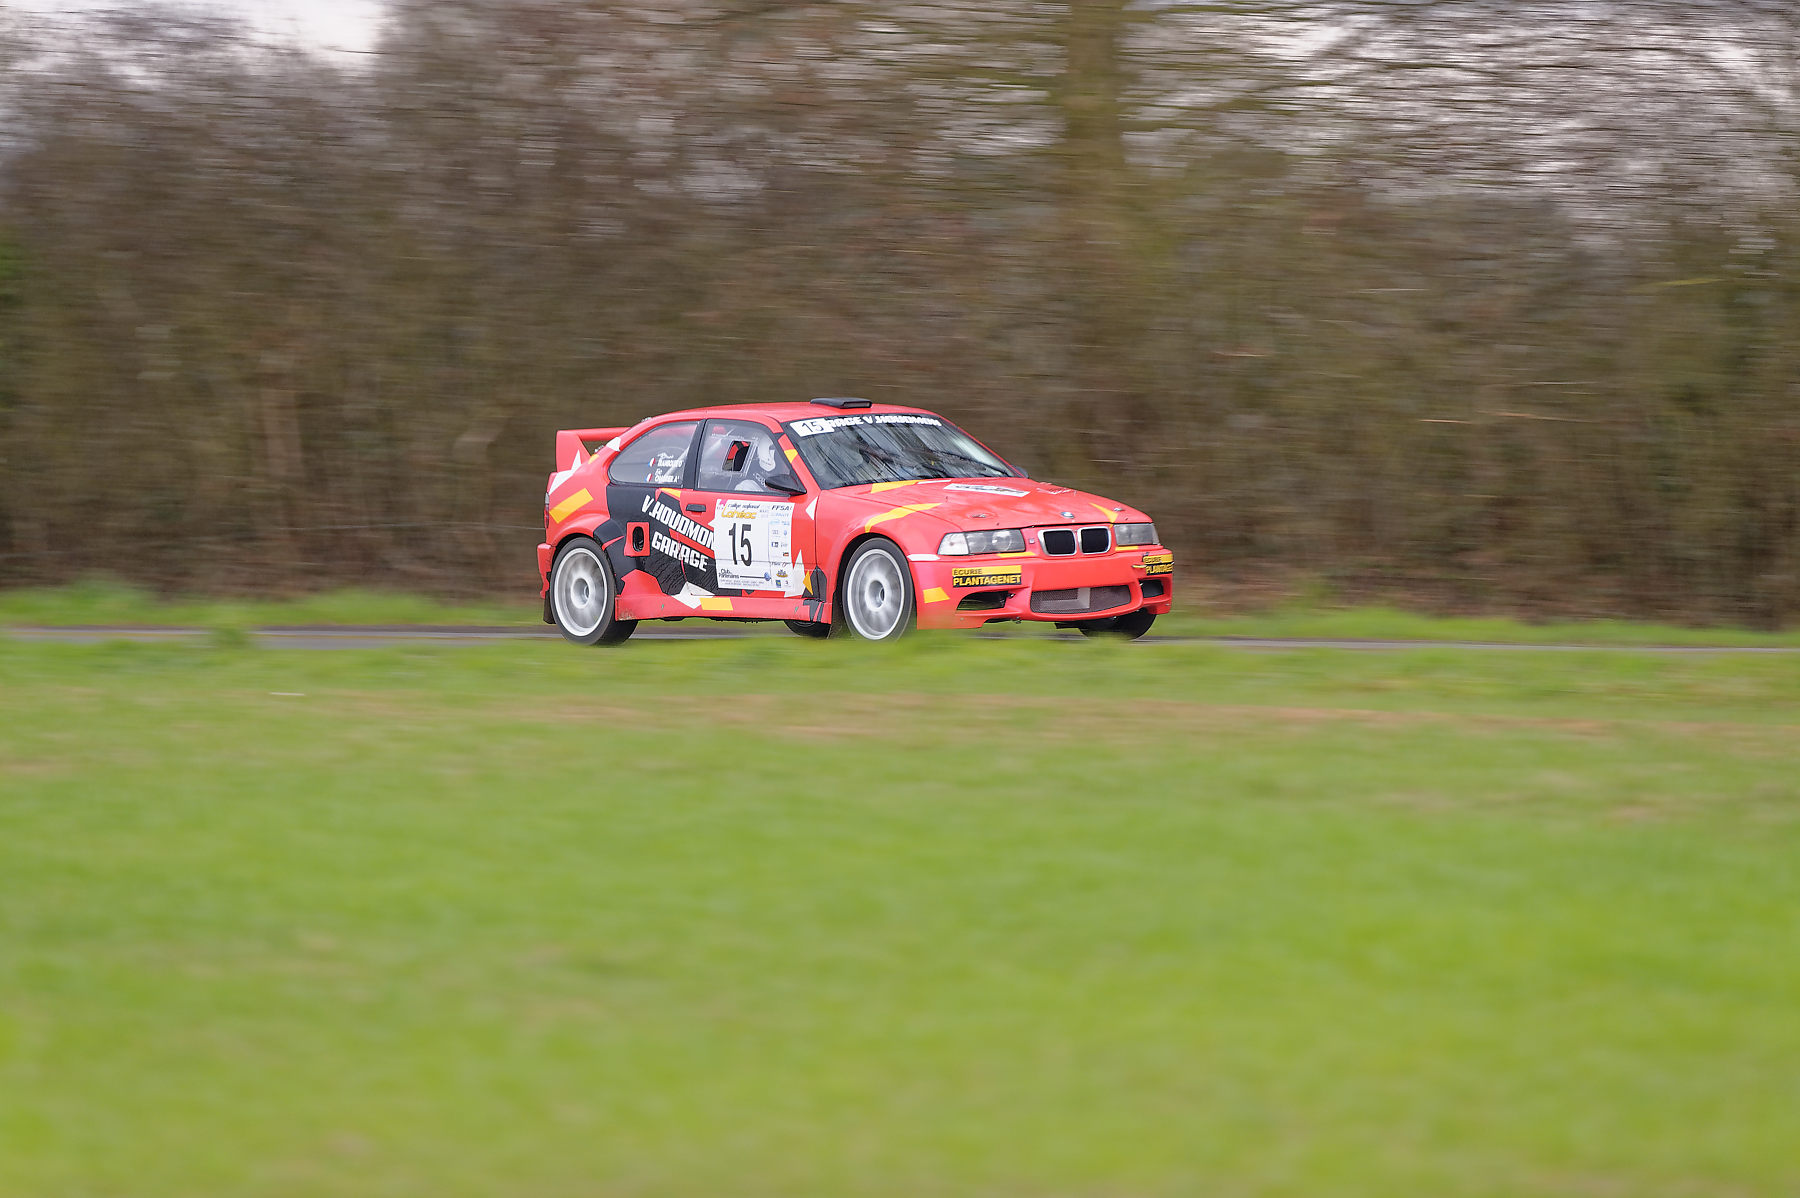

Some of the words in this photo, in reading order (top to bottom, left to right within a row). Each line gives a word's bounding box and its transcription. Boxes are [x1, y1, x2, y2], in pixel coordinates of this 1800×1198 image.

[802, 420, 824, 433] 15
[651, 531, 707, 572] GARAGE
[728, 522, 752, 566] 15
[953, 575, 1022, 586] PLANTAGENET
